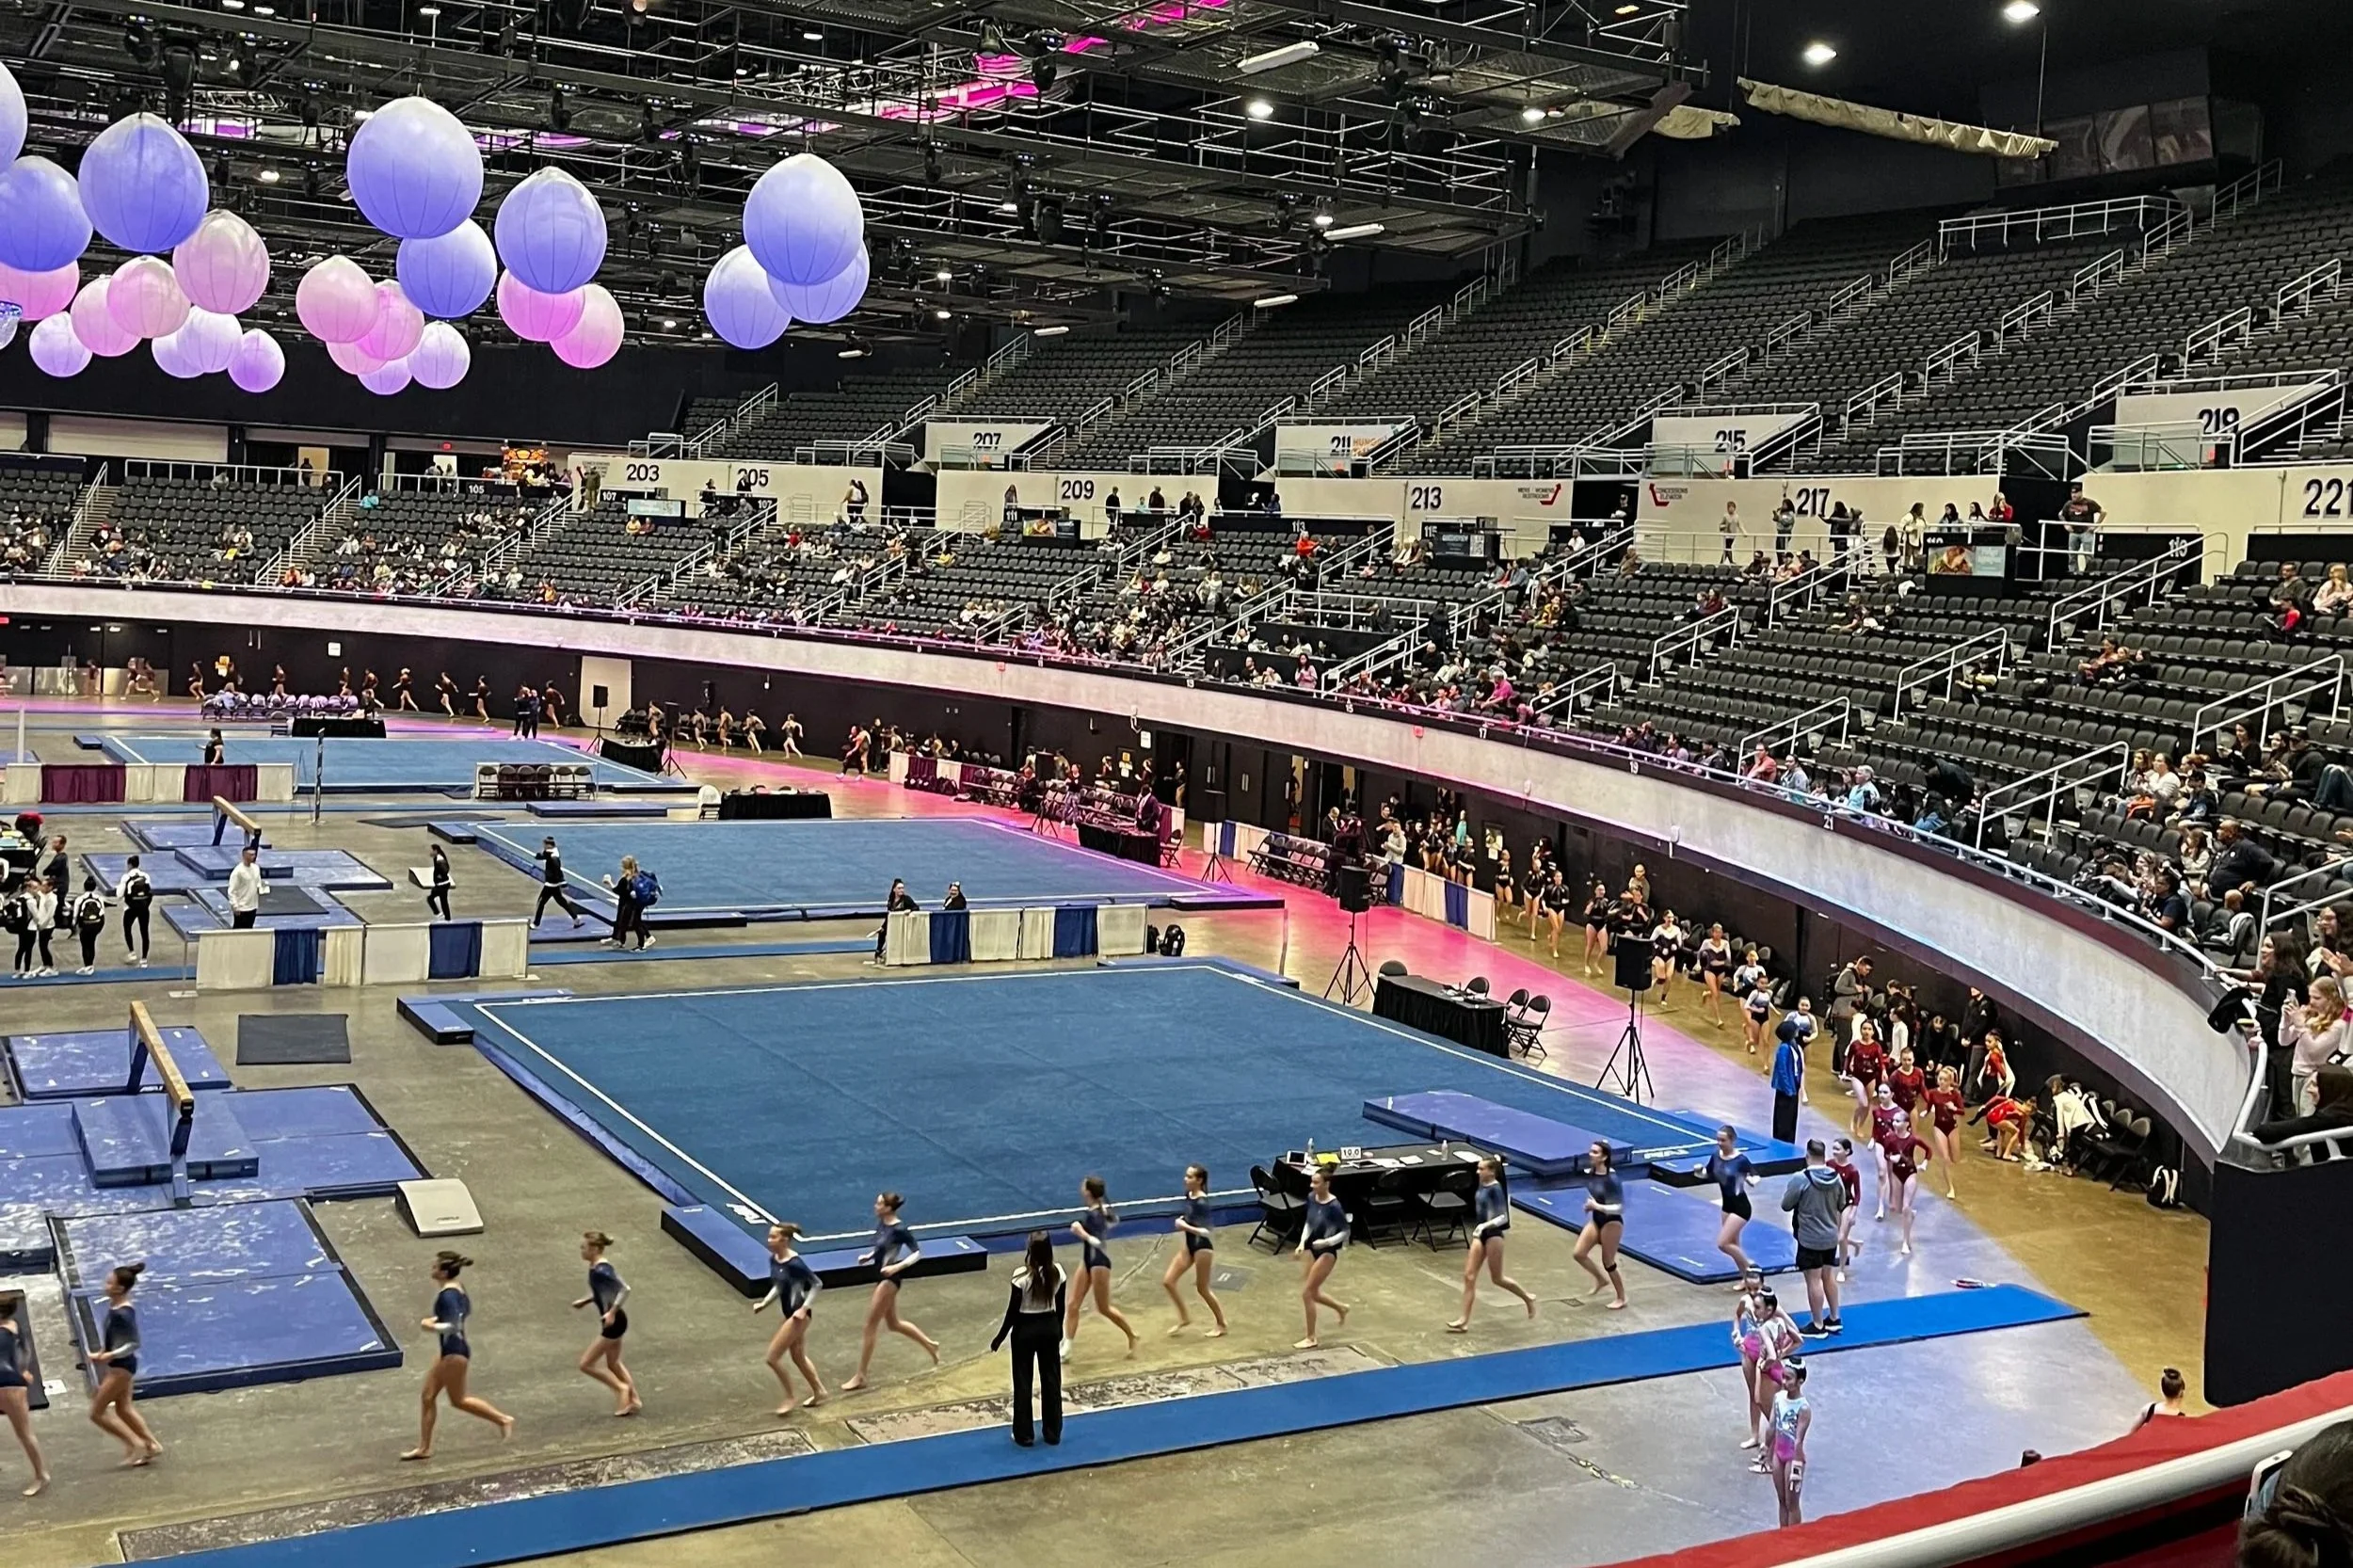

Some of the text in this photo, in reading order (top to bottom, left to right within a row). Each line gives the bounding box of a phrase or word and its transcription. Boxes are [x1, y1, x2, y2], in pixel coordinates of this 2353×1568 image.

[2198, 407, 2239, 433] 219
[973, 432, 1001, 449] 207
[1714, 430, 1746, 452] 215
[626, 464, 660, 481] 203
[737, 469, 769, 487] 205
[469, 485, 485, 494] 105
[602, 492, 616, 501] 107
[1062, 480, 1095, 500] 209
[758, 500, 772, 509] 107
[1411, 487, 1442, 510] 213
[1796, 488, 1830, 517] 217
[1006, 509, 1017, 520] 111
[1292, 520, 1305, 532] 113
[2169, 536, 2187, 557] 119
[1629, 761, 1639, 774] 19
[1823, 814, 1833, 830] 21
